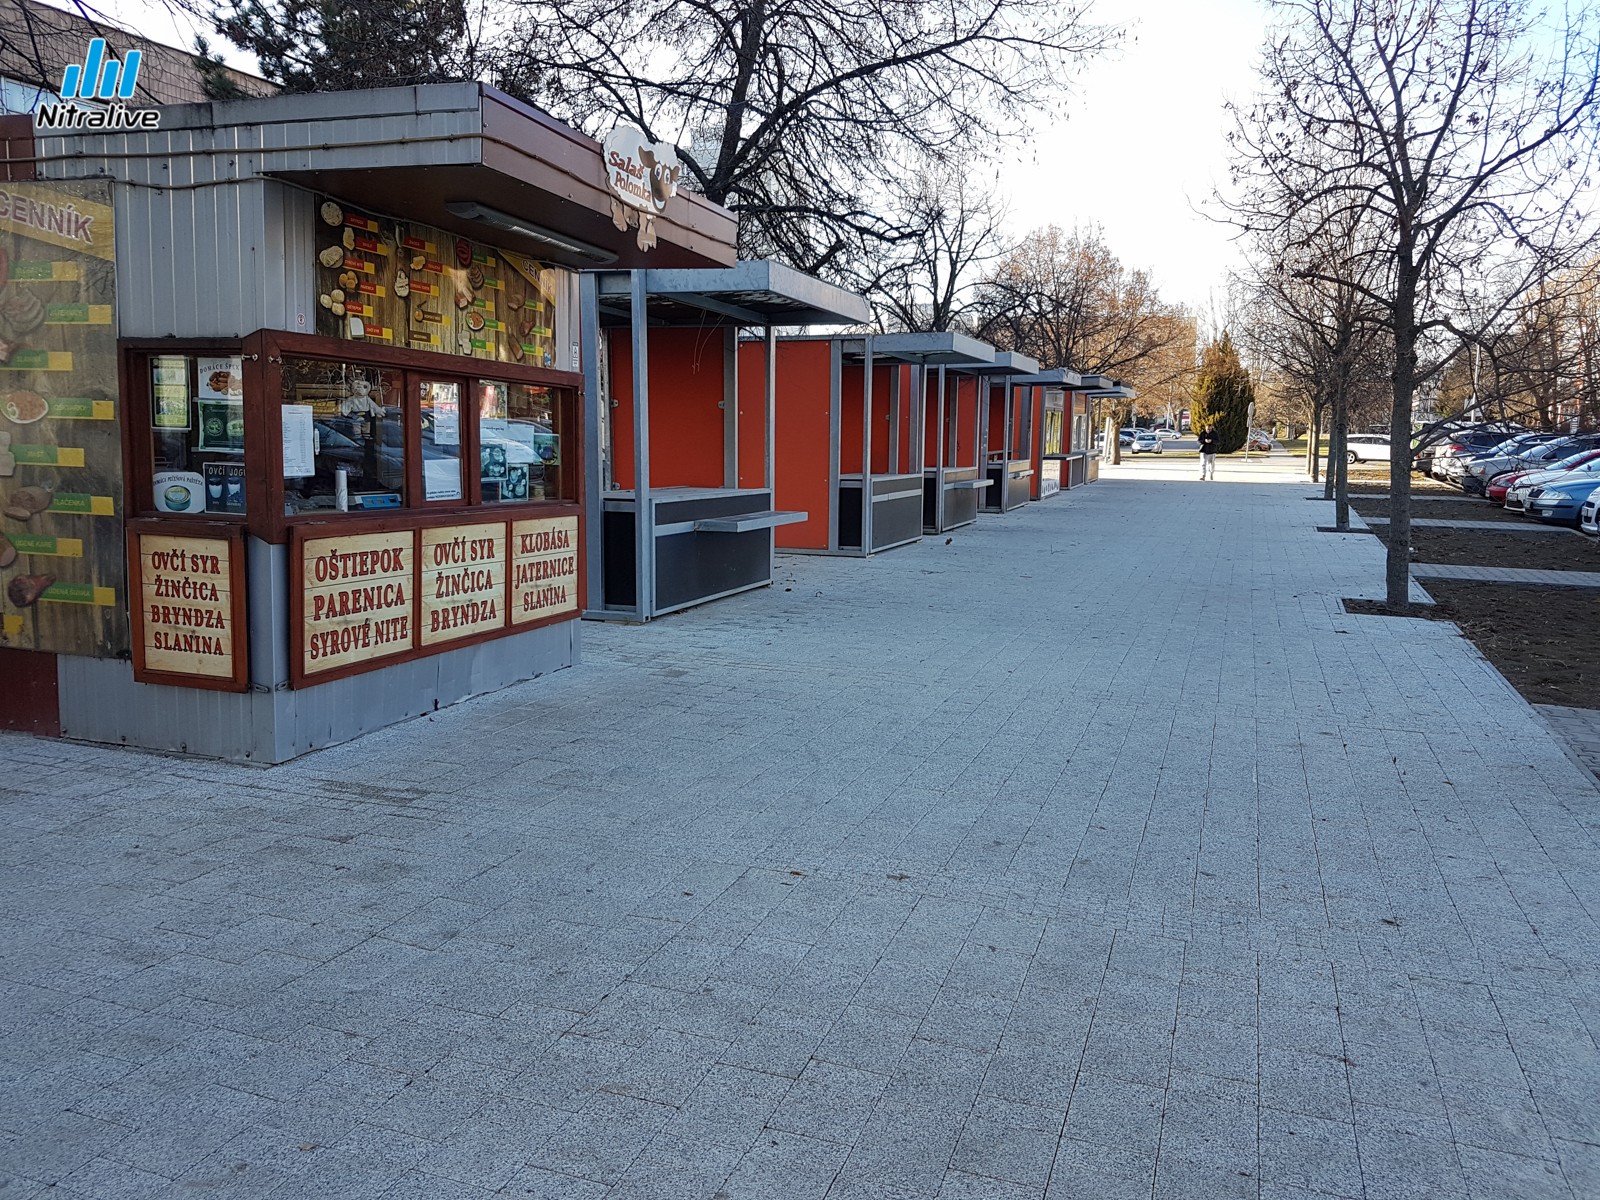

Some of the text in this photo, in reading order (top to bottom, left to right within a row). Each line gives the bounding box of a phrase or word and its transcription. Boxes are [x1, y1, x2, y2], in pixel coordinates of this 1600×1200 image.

[614, 171, 652, 203] Polomka
[208, 465, 226, 476] OVČÍ
[434, 536, 495, 566] OVČÍ SYR
[520, 526, 570, 554] KLOBÁSA
[151, 549, 220, 574] OVČÍ SYR
[315, 547, 404, 582] OŠTIEPOK
[515, 556, 574, 589] JATERNICE
[155, 574, 219, 601] ŽINČICA
[435, 567, 493, 598] ŽINČICA
[313, 583, 405, 621] PARENICA
[523, 585, 566, 612] SLANINA
[151, 605, 225, 629] BRYNDZA
[431, 599, 496, 632] BRYNDZA
[154, 631, 224, 656] SLANINA
[310, 616, 408, 660] SYROVÉ NITE
